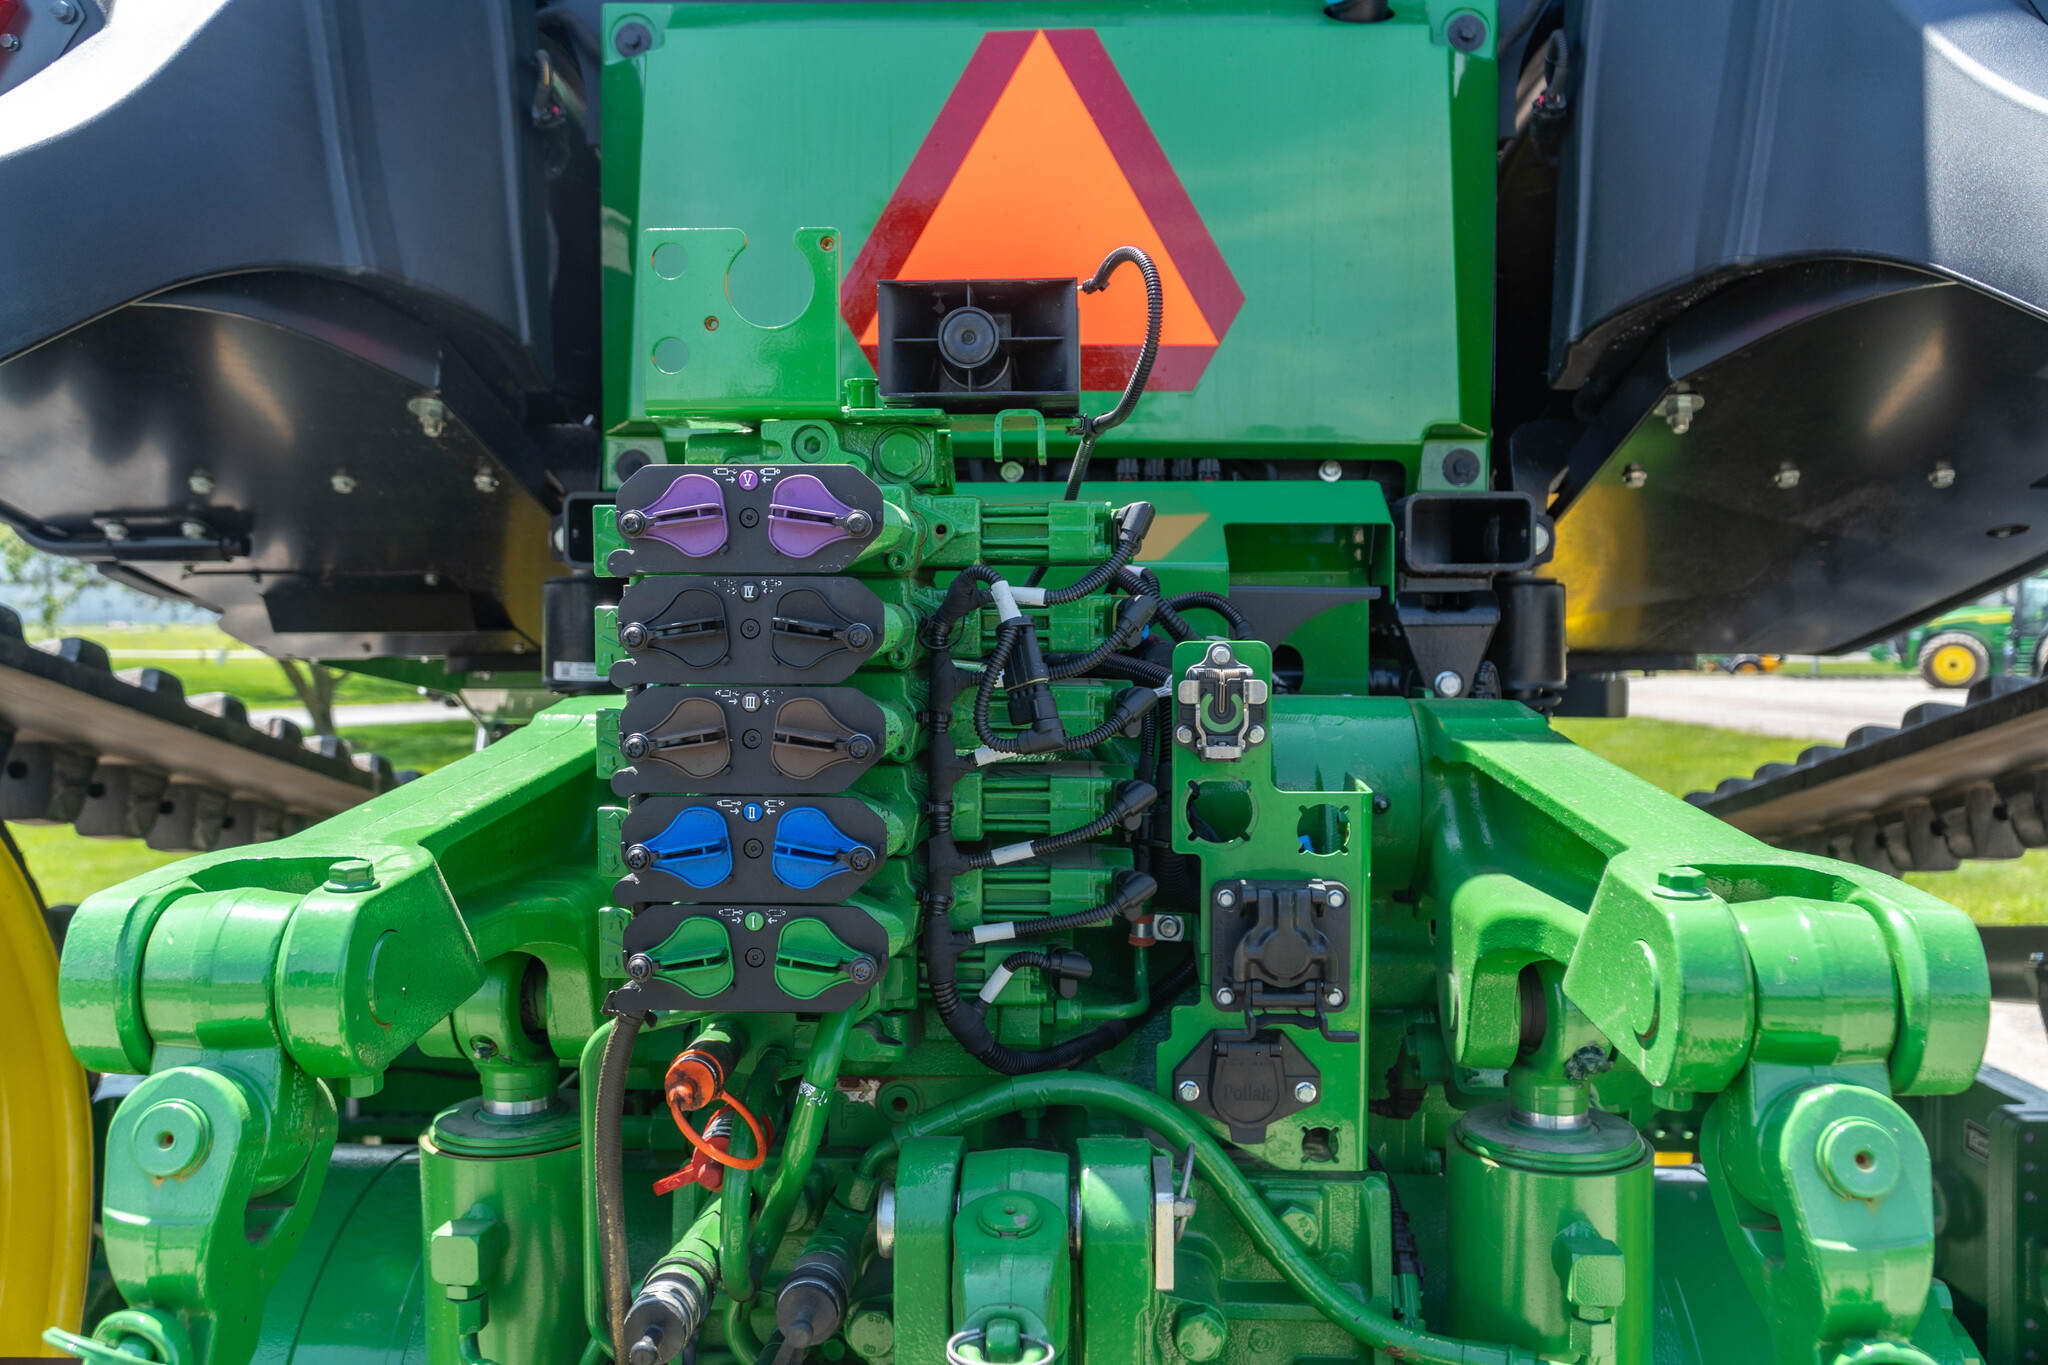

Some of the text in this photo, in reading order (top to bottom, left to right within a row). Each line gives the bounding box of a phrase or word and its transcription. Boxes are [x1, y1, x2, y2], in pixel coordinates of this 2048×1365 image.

[743, 473, 753, 487] V
[743, 585, 754, 599] IV
[745, 696, 756, 709] III
[748, 807, 756, 819] II
[1223, 1083, 1273, 1101] Pollak
